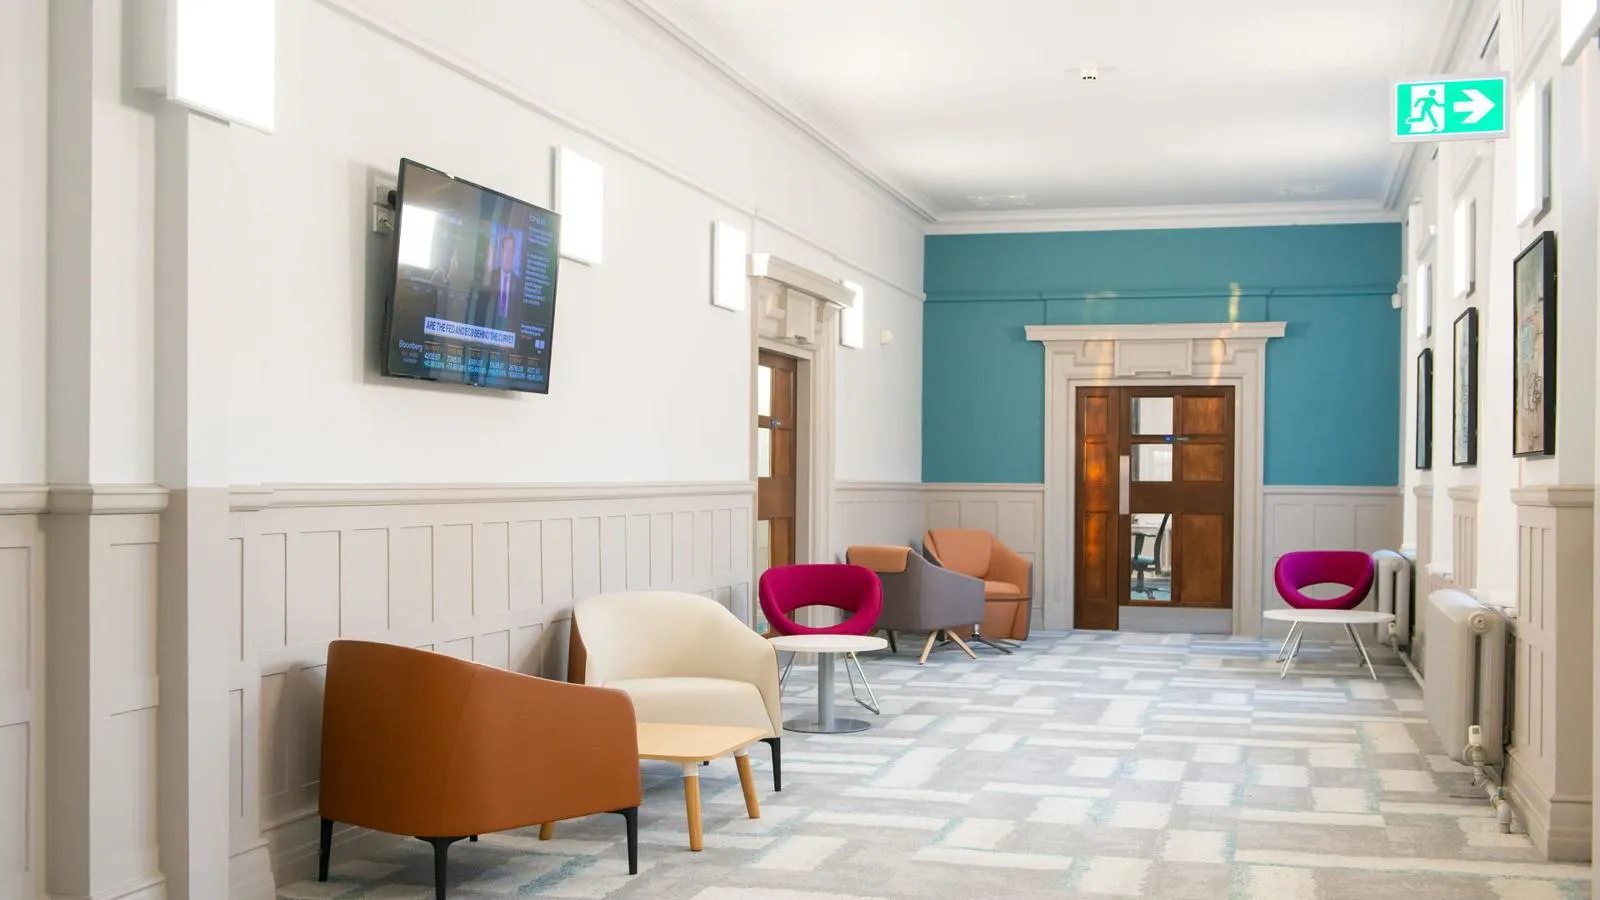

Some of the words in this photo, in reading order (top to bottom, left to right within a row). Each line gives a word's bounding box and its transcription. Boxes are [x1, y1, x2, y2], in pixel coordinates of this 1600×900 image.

[426, 319, 436, 330] ARE
[436, 322, 446, 332] THE
[446, 323, 455, 333] FED
[455, 325, 464, 335] AND
[473, 328, 490, 339] BEHIND
[490, 331, 498, 341] THE
[398, 339, 423, 352] Bloomberg
